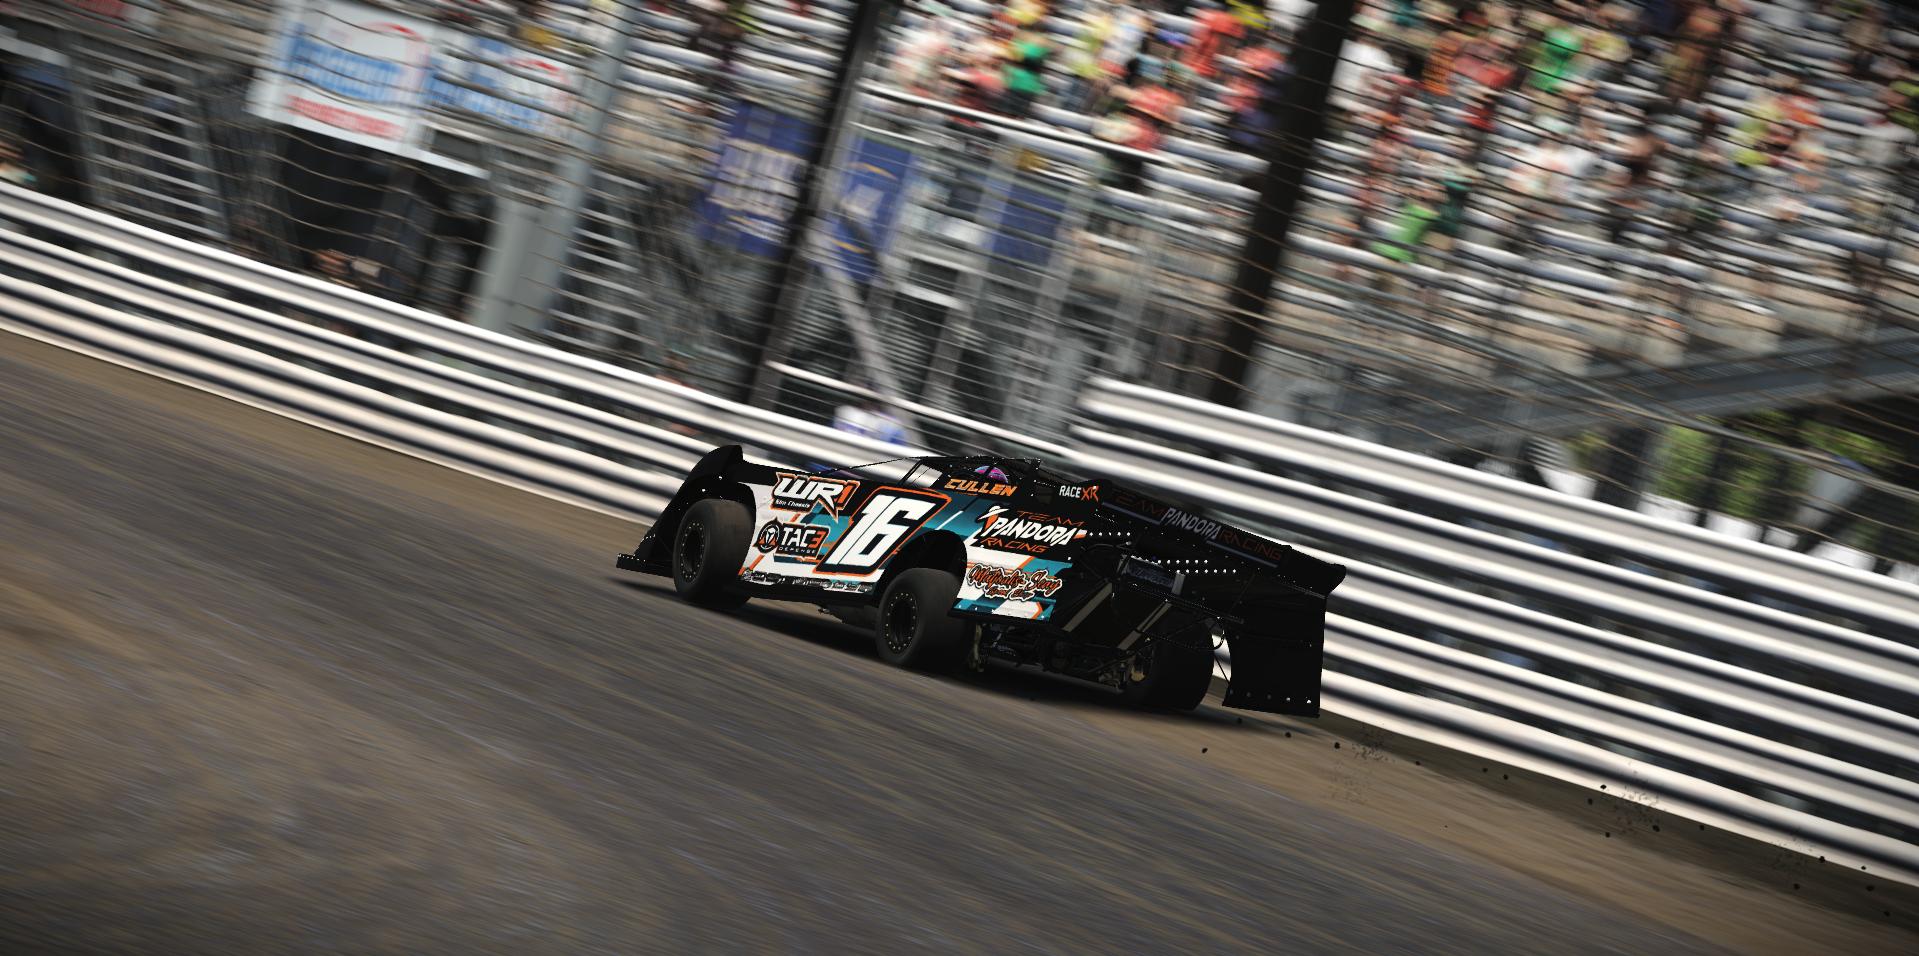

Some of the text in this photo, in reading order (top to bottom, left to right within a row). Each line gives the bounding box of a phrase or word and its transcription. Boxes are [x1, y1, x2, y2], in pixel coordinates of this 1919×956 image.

[944, 478, 1018, 497] CULLEN
[1017, 510, 1087, 527] TEAM
[780, 527, 827, 549] TAC3
[824, 493, 937, 567] 16
[981, 517, 1078, 546] PANDORA
[1160, 507, 1222, 540] PANDORA
[1218, 530, 1282, 561] RACING
[981, 537, 1051, 553] RACING
